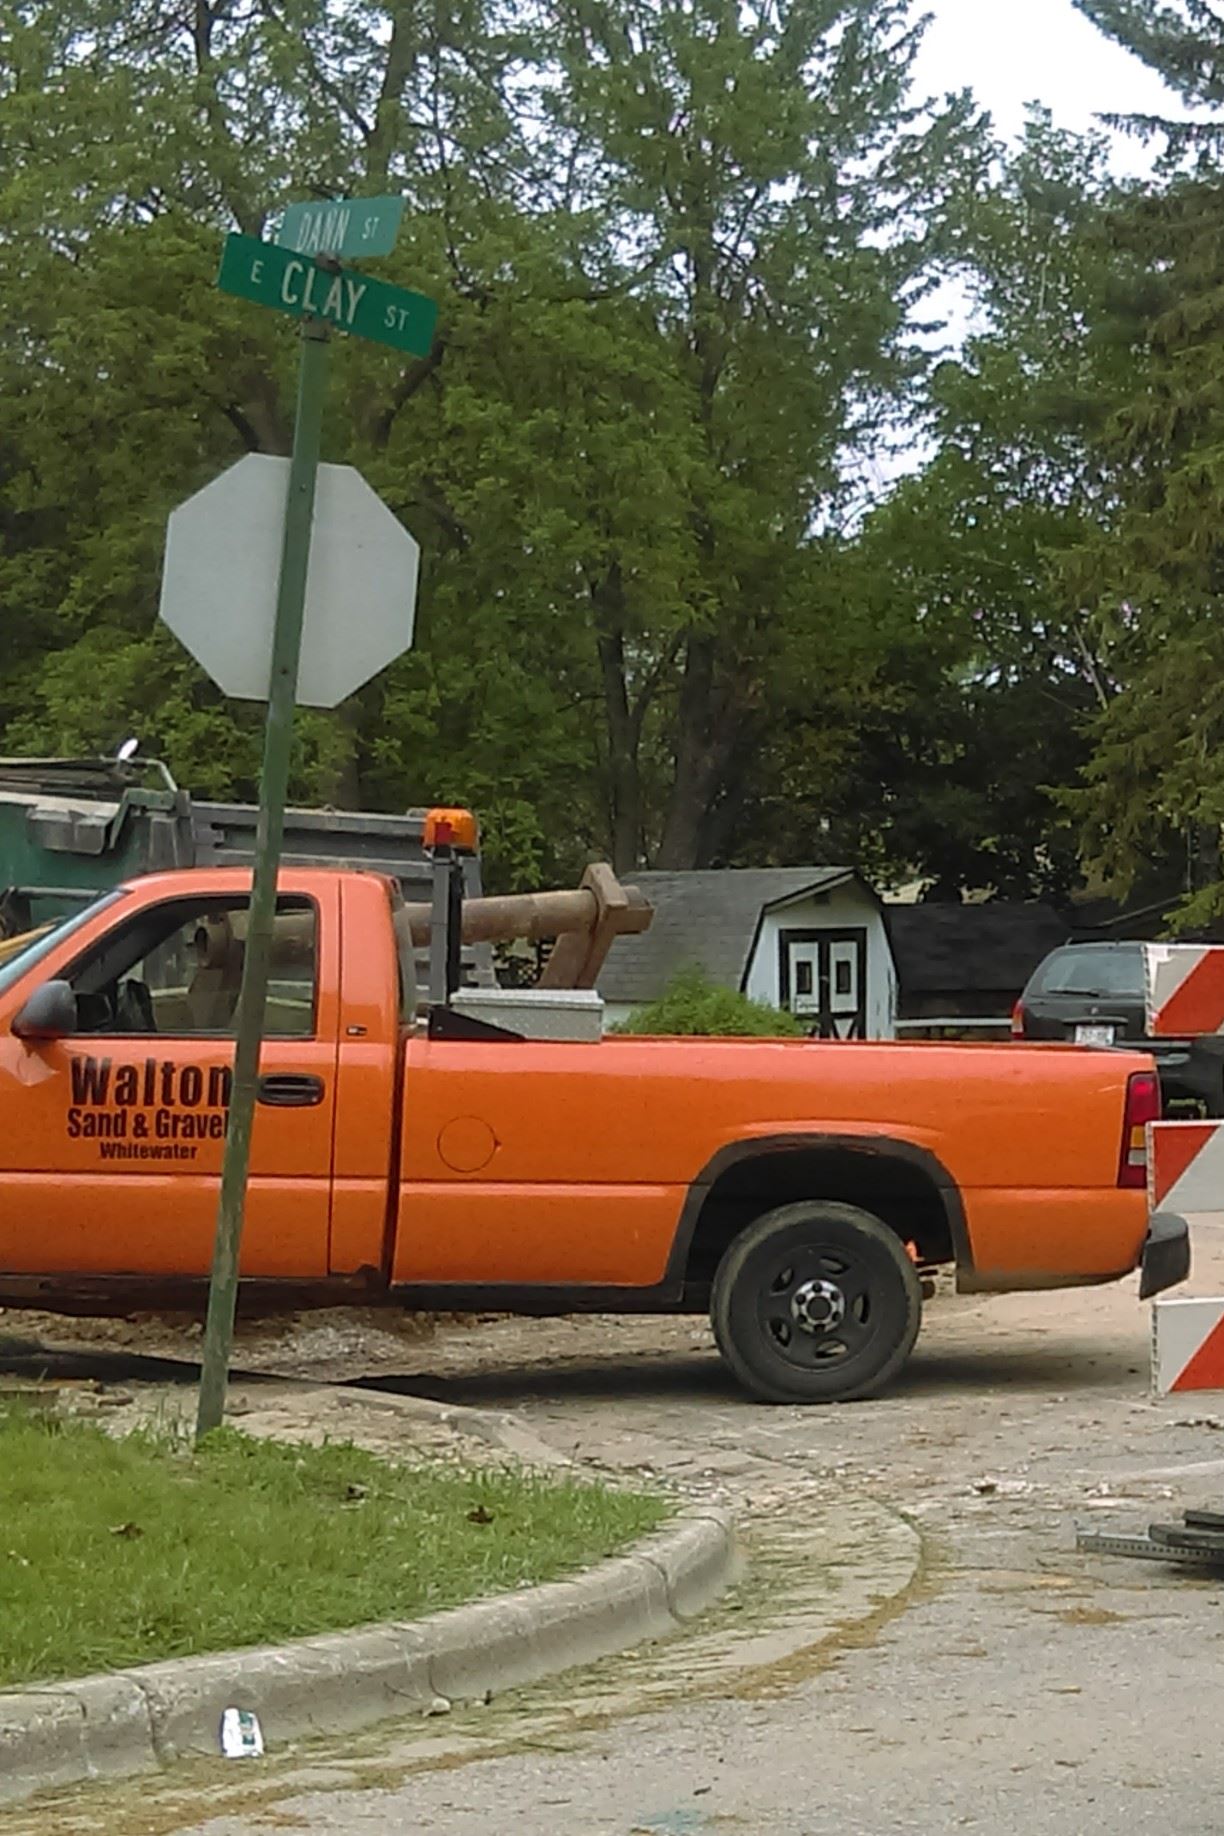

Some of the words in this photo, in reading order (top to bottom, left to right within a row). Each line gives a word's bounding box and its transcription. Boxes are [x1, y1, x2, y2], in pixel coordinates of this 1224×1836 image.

[297, 208, 350, 252] DANN
[362, 216, 380, 240] ST
[250, 260, 265, 284] E
[281, 260, 366, 325] CLAY
[384, 305, 410, 331] ST
[70, 1056, 233, 1107] Walton
[67, 1107, 127, 1139] Sand
[133, 1113, 149, 1138] &
[100, 1142, 198, 1160] Whitewater
